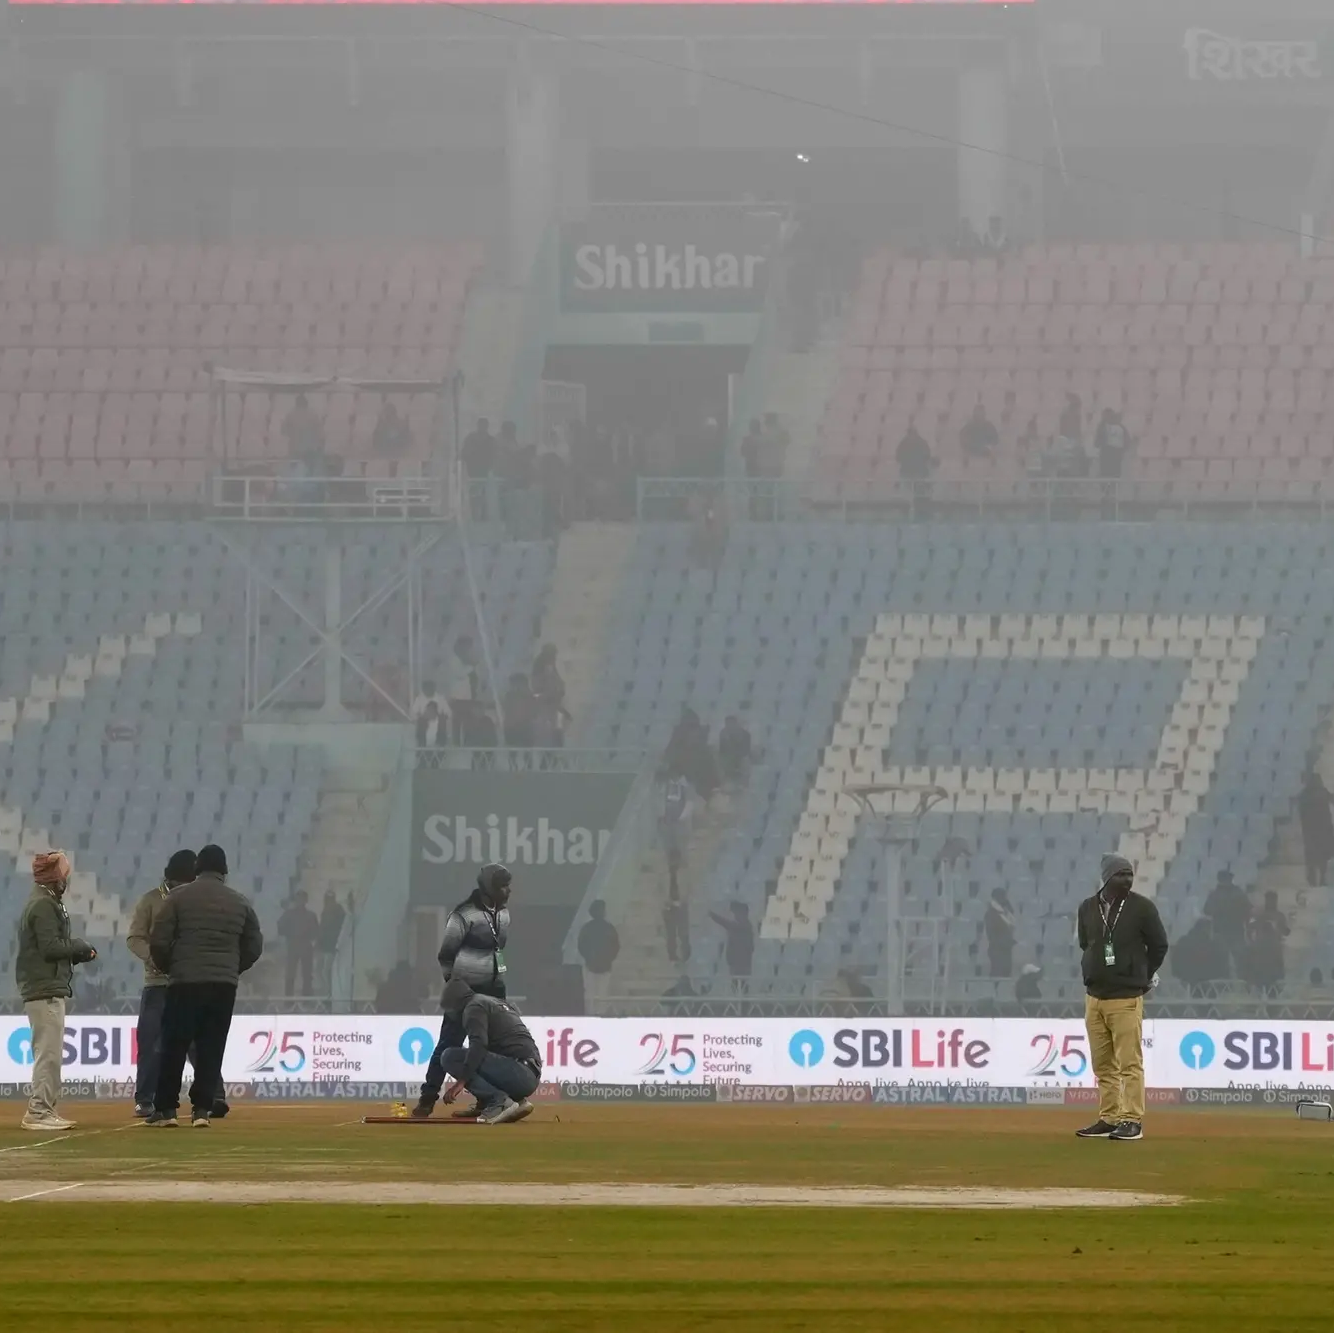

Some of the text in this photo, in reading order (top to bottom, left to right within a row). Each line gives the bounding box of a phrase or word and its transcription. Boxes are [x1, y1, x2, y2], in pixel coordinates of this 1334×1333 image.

[573, 242, 766, 290] Shikhar
[313, 1031, 373, 1045] Protecting
[703, 1034, 763, 1048] Protecting
[249, 1030, 306, 1073] 25
[547, 1027, 600, 1067] ife
[639, 1032, 696, 1076] 25
[832, 1028, 991, 1069] SBI Life
[1223, 1030, 1293, 1071] SBI
[1030, 1034, 1088, 1078] 25
[312, 1058, 362, 1072] Securing
[702, 1061, 752, 1075] Securing
[255, 1082, 327, 1098] ASTRAL
[733, 1087, 788, 1102] SERVO
[874, 1086, 947, 1103] ASTRAL
[952, 1086, 1024, 1103] ASTRAL
[1198, 1089, 1253, 1105] Simpolo
